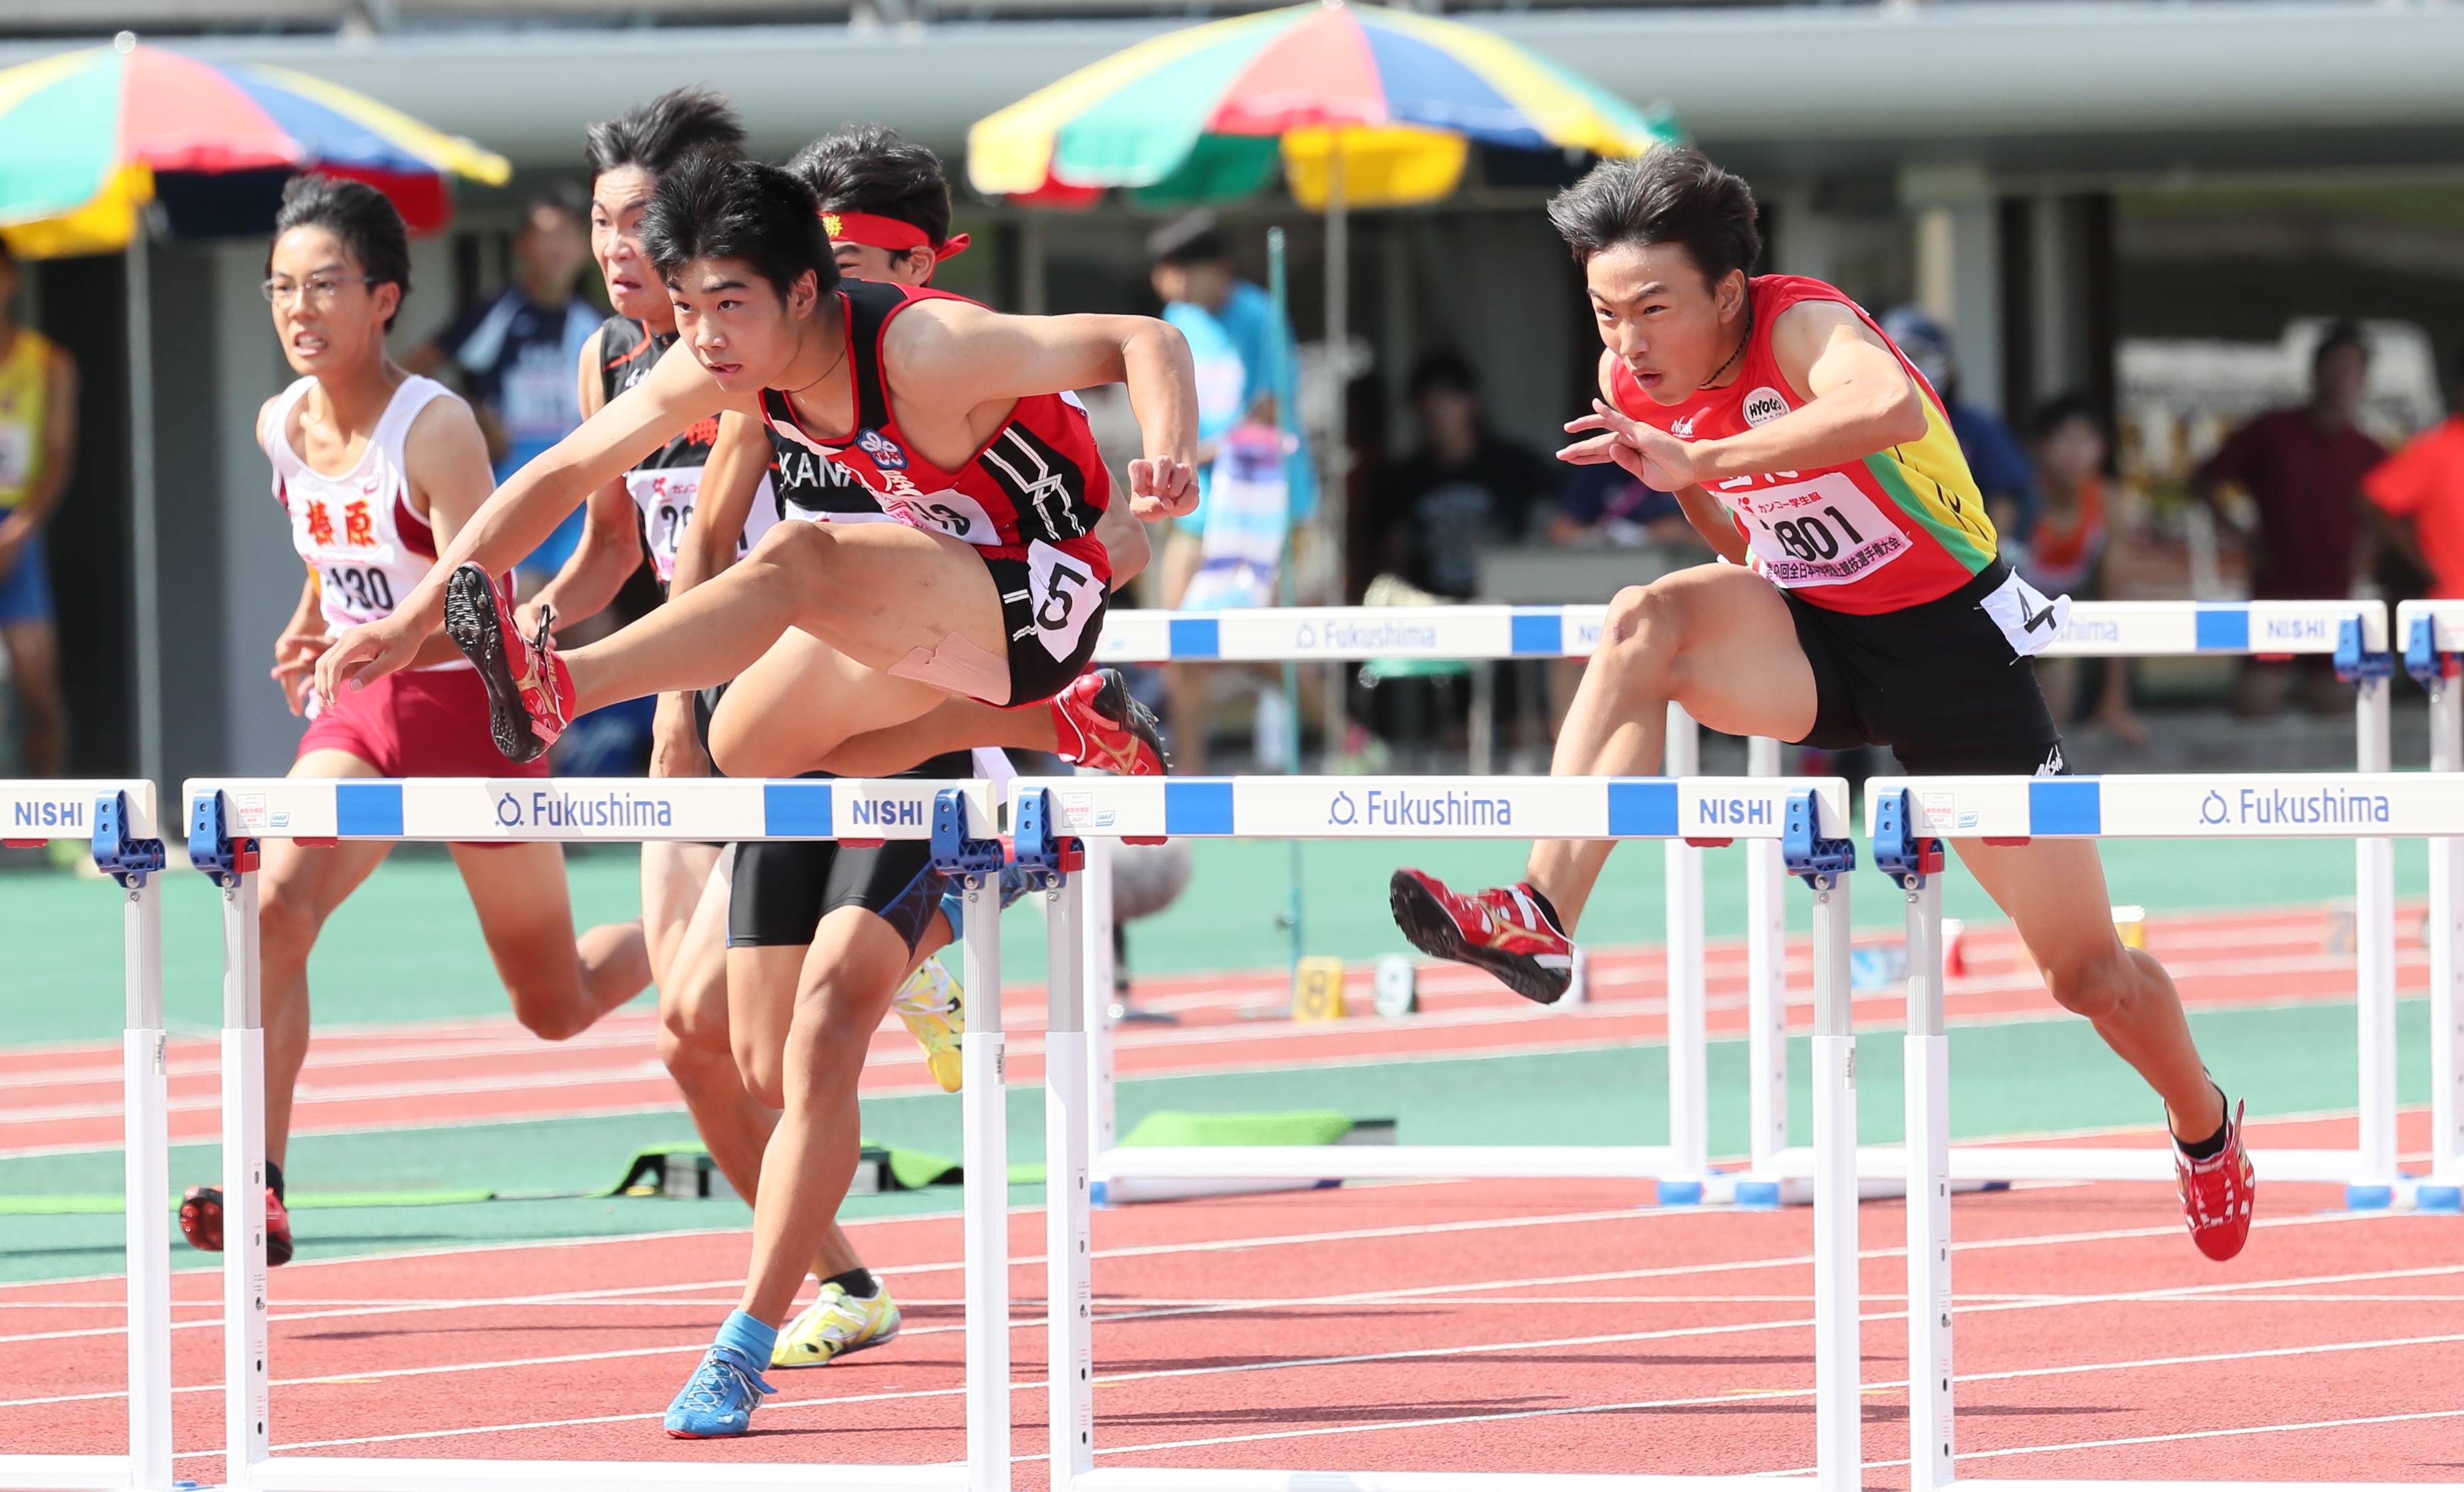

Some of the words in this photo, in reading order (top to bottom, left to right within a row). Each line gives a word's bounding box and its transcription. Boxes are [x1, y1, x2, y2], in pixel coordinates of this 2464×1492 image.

[1036, 563, 1087, 631] 5
[2016, 587, 2057, 634] 4
[1324, 620, 1437, 649] Fukushima
[2267, 619, 2325, 638] NISHI
[15, 801, 83, 826] NISHI
[533, 792, 672, 826] Fukushima
[852, 800, 923, 826] NISHI
[1367, 790, 1511, 825] Fukushima
[1700, 799, 1772, 825] NISHI
[2240, 788, 2390, 824] Fukushima
